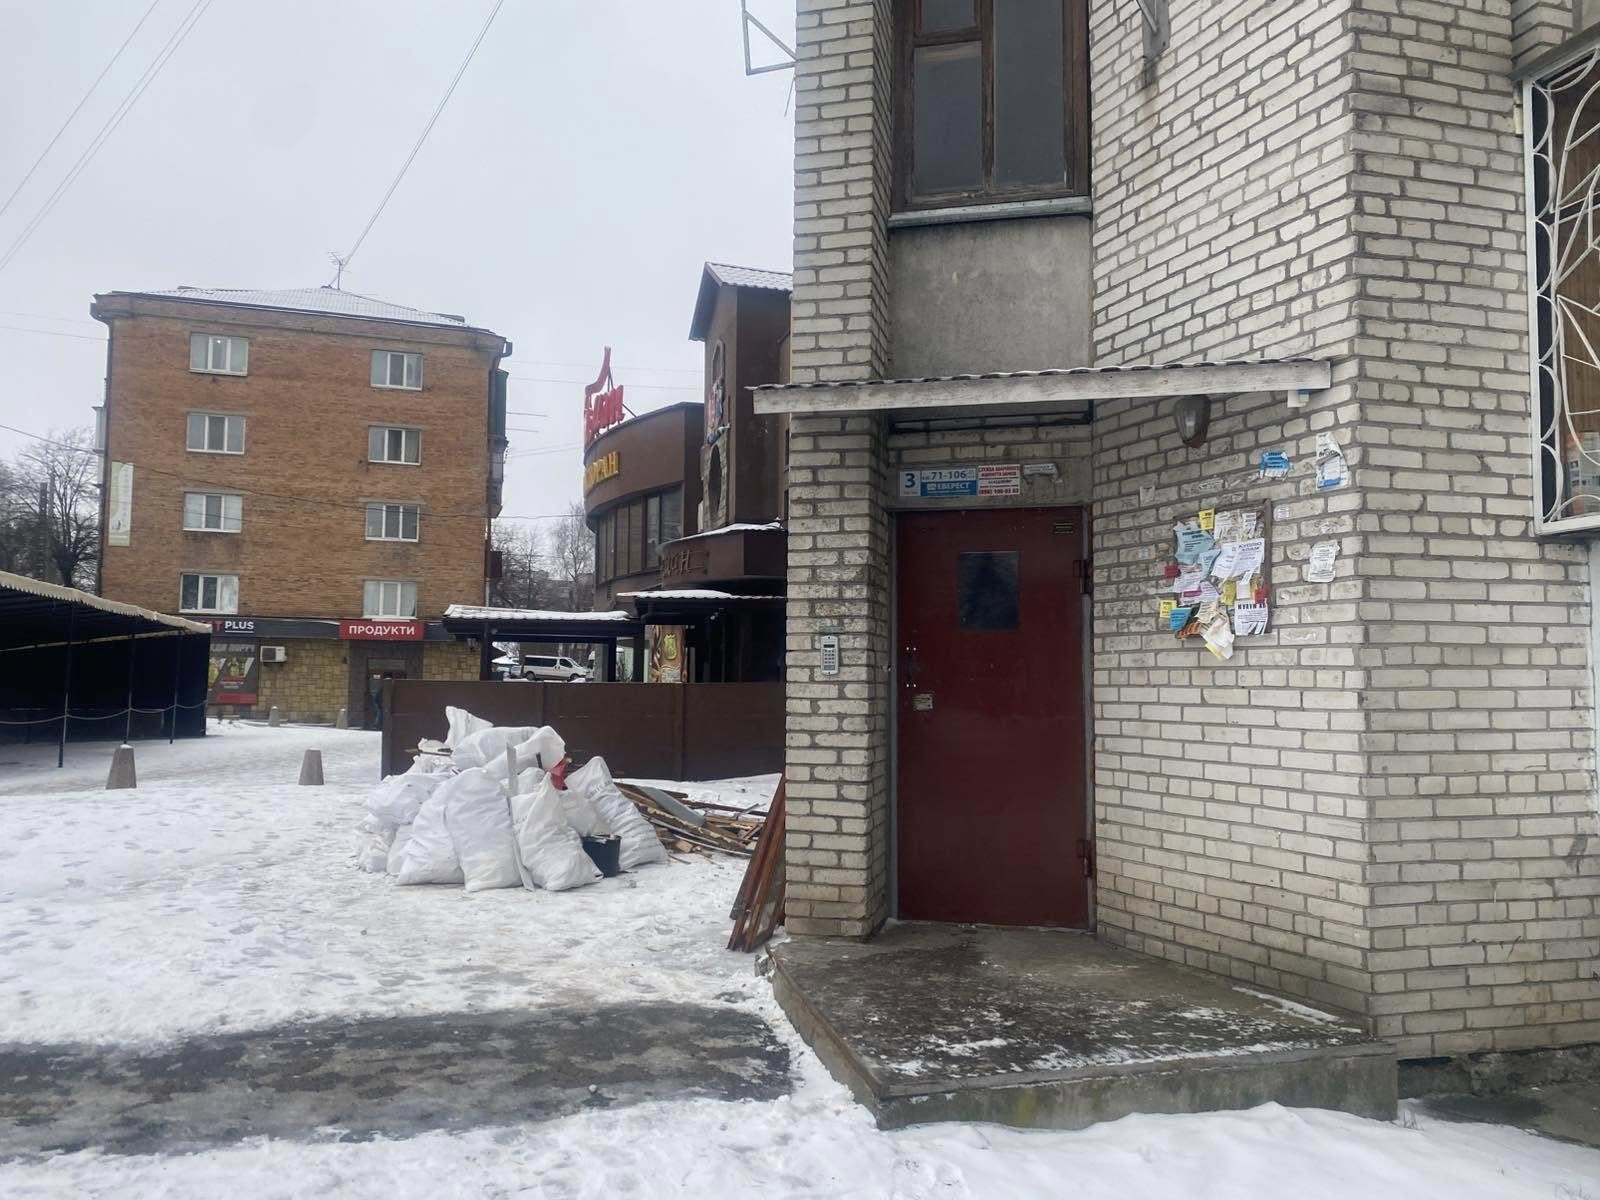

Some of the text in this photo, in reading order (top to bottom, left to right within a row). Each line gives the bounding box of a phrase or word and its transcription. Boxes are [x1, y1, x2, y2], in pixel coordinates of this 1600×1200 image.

[931, 470, 967, 480] 71-106
[904, 473, 916, 488] 3
[225, 621, 254, 630] PLUS
[348, 625, 415, 636] ПРОДУКТИ
